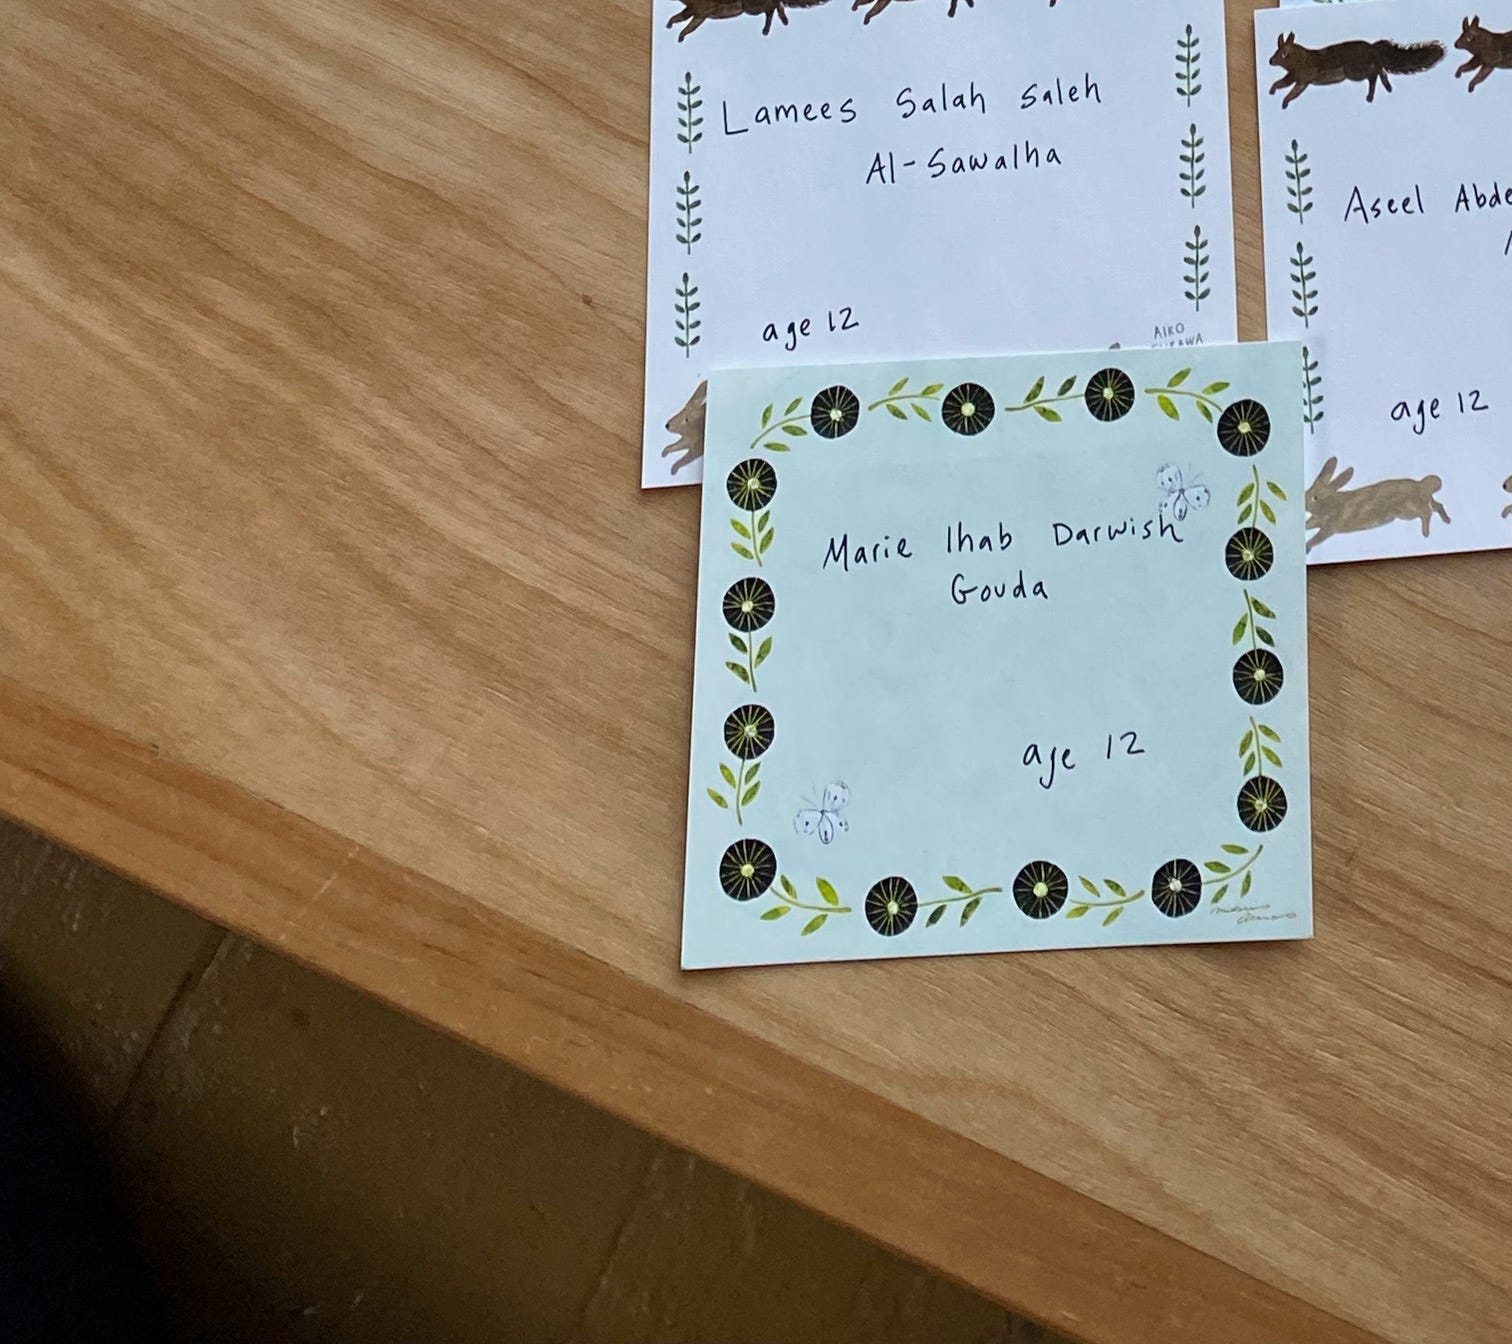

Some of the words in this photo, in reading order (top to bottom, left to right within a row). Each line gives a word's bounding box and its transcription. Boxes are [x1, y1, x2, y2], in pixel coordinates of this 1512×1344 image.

[722, 97, 857, 136] Lamees
[895, 80, 986, 120] Salah
[865, 139, 1062, 185] Al-Sawalha
[1343, 183, 1425, 225] Aseel
[762, 318, 811, 352] age
[828, 306, 860, 333] 12
[1154, 322, 1184, 339] AIKO
[1390, 397, 1441, 436] age
[1457, 389, 1490, 414] 12
[822, 532, 913, 573] Marie
[946, 520, 1013, 554] Ihab
[1052, 512, 1184, 548] Darwish
[951, 569, 1049, 606] Gouda
[1022, 743, 1076, 790] age
[1106, 730, 1146, 760] 12
